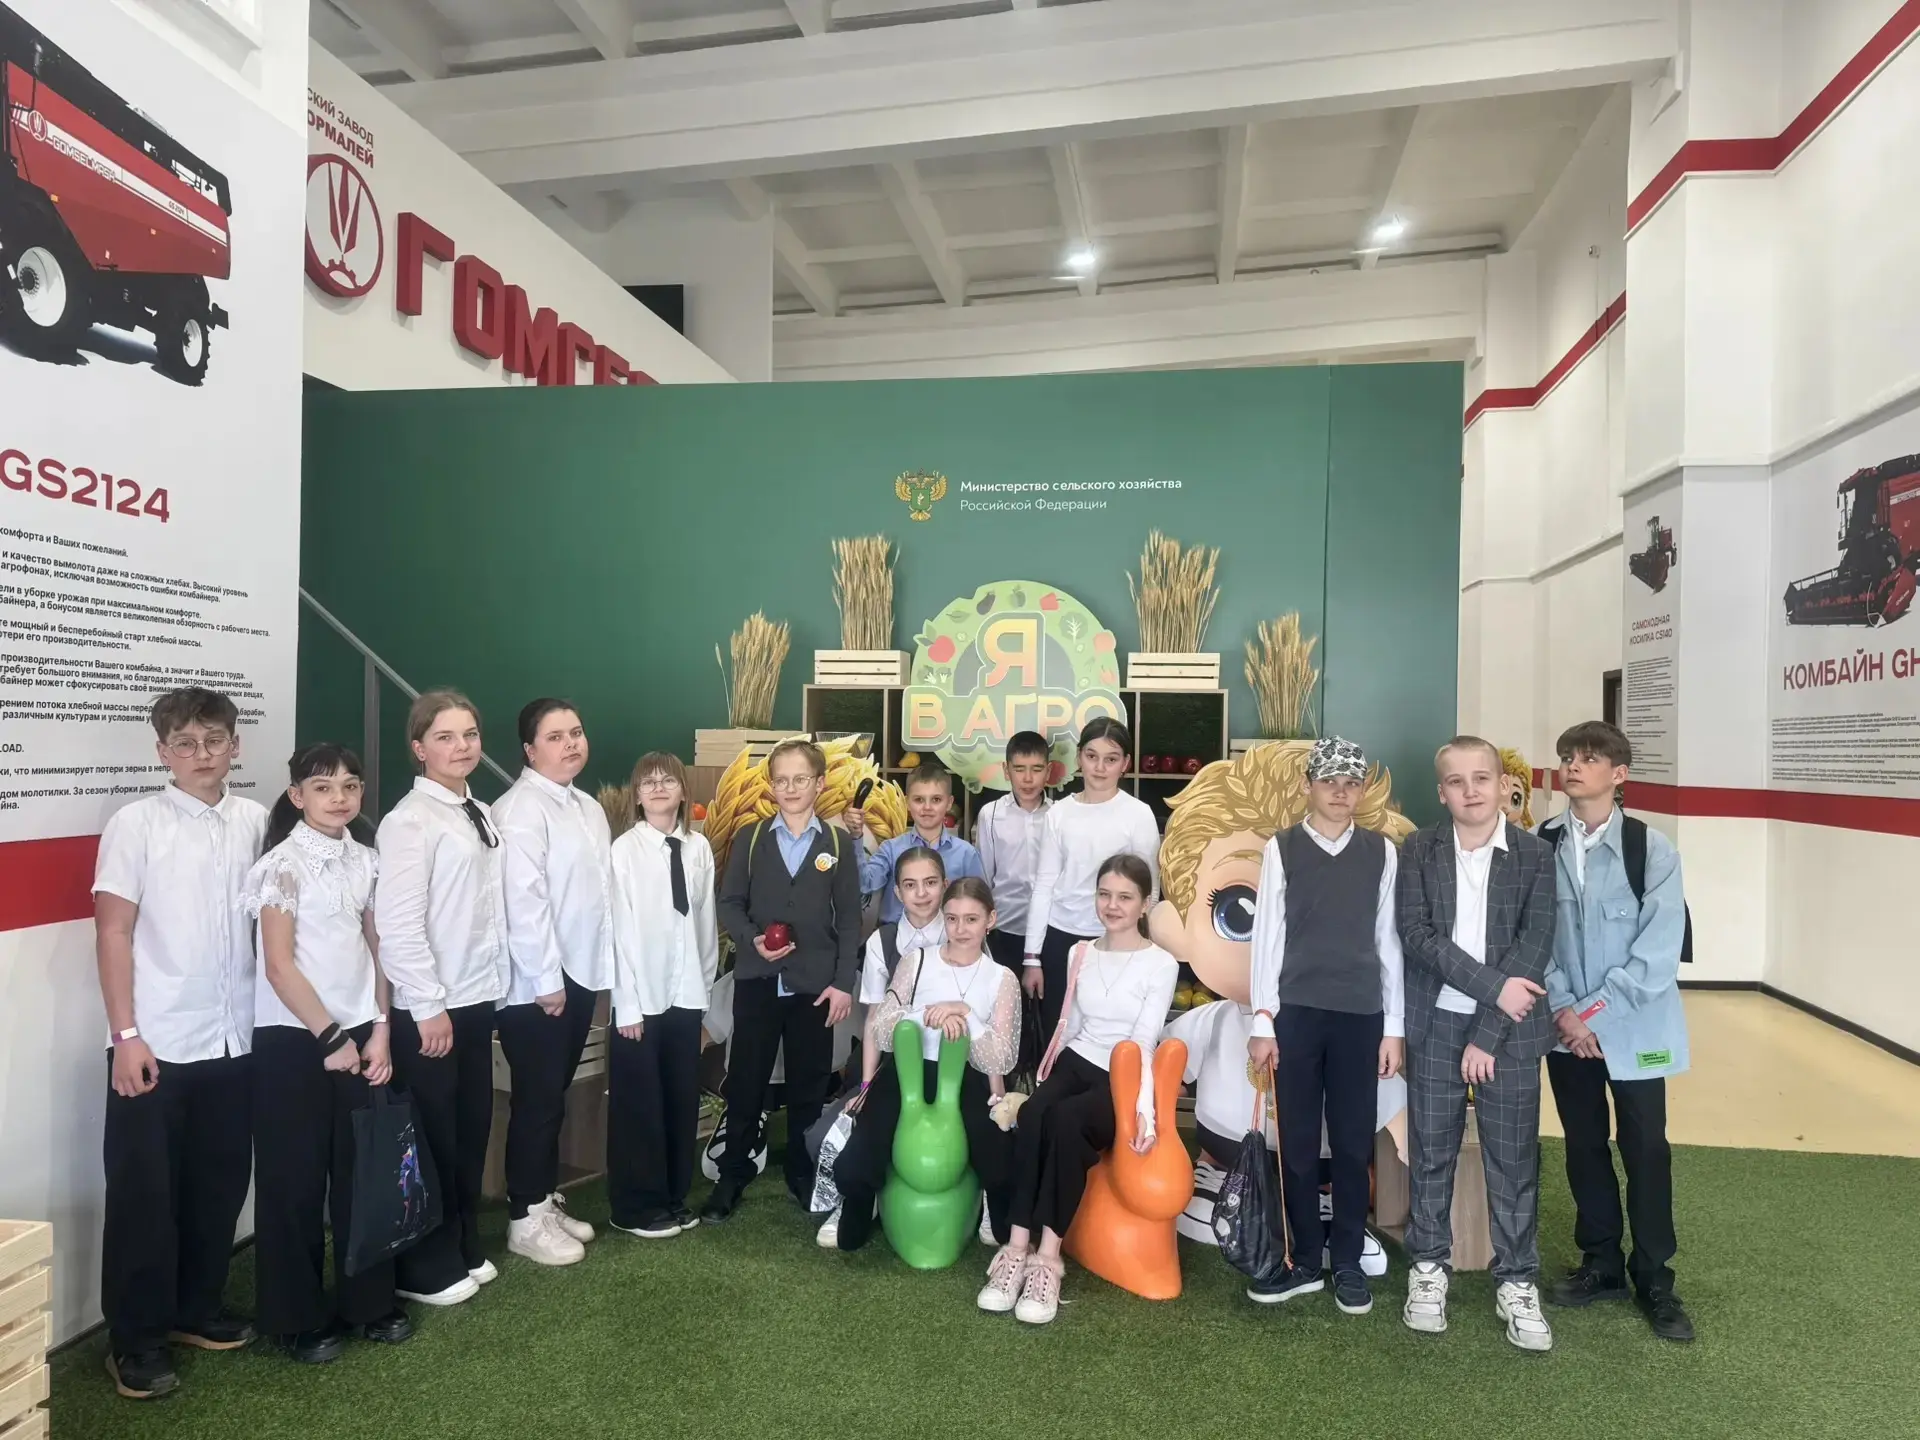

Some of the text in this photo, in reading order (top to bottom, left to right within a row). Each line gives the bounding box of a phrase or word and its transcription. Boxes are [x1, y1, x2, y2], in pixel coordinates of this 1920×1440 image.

[337, 110, 374, 149] ЗАВОД
[52, 134, 116, 183] GOMSELMASH
[0, 448, 170, 524] GS2124
[960, 478, 1182, 494] Министерство сельского хозяйства
[960, 498, 1108, 512] Российской Федерации
[53, 535, 80, 549] Ваших
[82, 542, 128, 558] пожеланий.
[0, 562, 221, 604] агрофонах, исключая возможность ошибки комбайнера.
[2, 550, 248, 598] и качество вымолота даже на сложных хлебах. Высокий уровень
[24, 586, 56, 599] уборке
[58, 592, 90, 602] урожая
[90, 598, 106, 606] при
[106, 600, 164, 614] максимальном
[166, 607, 202, 619] комфорте.
[47, 600, 84, 614] бонусом
[84, 607, 121, 618] является
[122, 612, 175, 626] великолепная
[176, 618, 215, 630] обзорность
[221, 624, 250, 635] рабочего
[250, 628, 271, 638] места.
[1632, 614, 1670, 631] САМОХОДНАЯ
[10, 620, 49, 631] мощный
[58, 623, 123, 640] бесперебойный
[124, 632, 146, 642] старт
[146, 633, 177, 645] хлебной
[178, 638, 203, 648] массы.
[26, 633, 41, 642] его
[42, 634, 132, 650] производительности.
[1630, 632, 1654, 646] КОСИЛКА
[984, 619, 1038, 687] Я
[0, 653, 94, 668] производительности
[94, 660, 124, 670] Вашего
[126, 663, 164, 674] комбайна,
[170, 667, 194, 676] значит
[200, 668, 224, 678] Вашего
[226, 671, 246, 680] труда.
[0, 664, 36, 676] требует
[38, 666, 80, 678] большого
[82, 671, 122, 682] внимания,
[134, 674, 172, 686] благодаря
[174, 676, 253, 689] электрогидравлической
[1783, 648, 1884, 690] КОМБАЙН
[0, 674, 34, 688] байнер
[35, 678, 64, 688] может
[66, 680, 128, 692] сфокусировать
[130, 683, 148, 692] своё
[244, 692, 264, 700] вещах,
[2, 711, 54, 721] различным
[56, 712, 100, 723] культурам
[108, 714, 145, 724] условиям
[36, 701, 66, 709] потока
[68, 702, 102, 710] хлебной
[240, 708, 266, 718] барабан,
[910, 692, 1119, 740] В АГРО
[0, 743, 24, 752] OAD.
[14, 768, 30, 776] что
[32, 766, 94, 776] минимизирует
[96, 766, 124, 775] потери
[125, 766, 148, 774] зерна
[0, 781, 256, 800] дом молотилки. За сезон уборки данная большое
